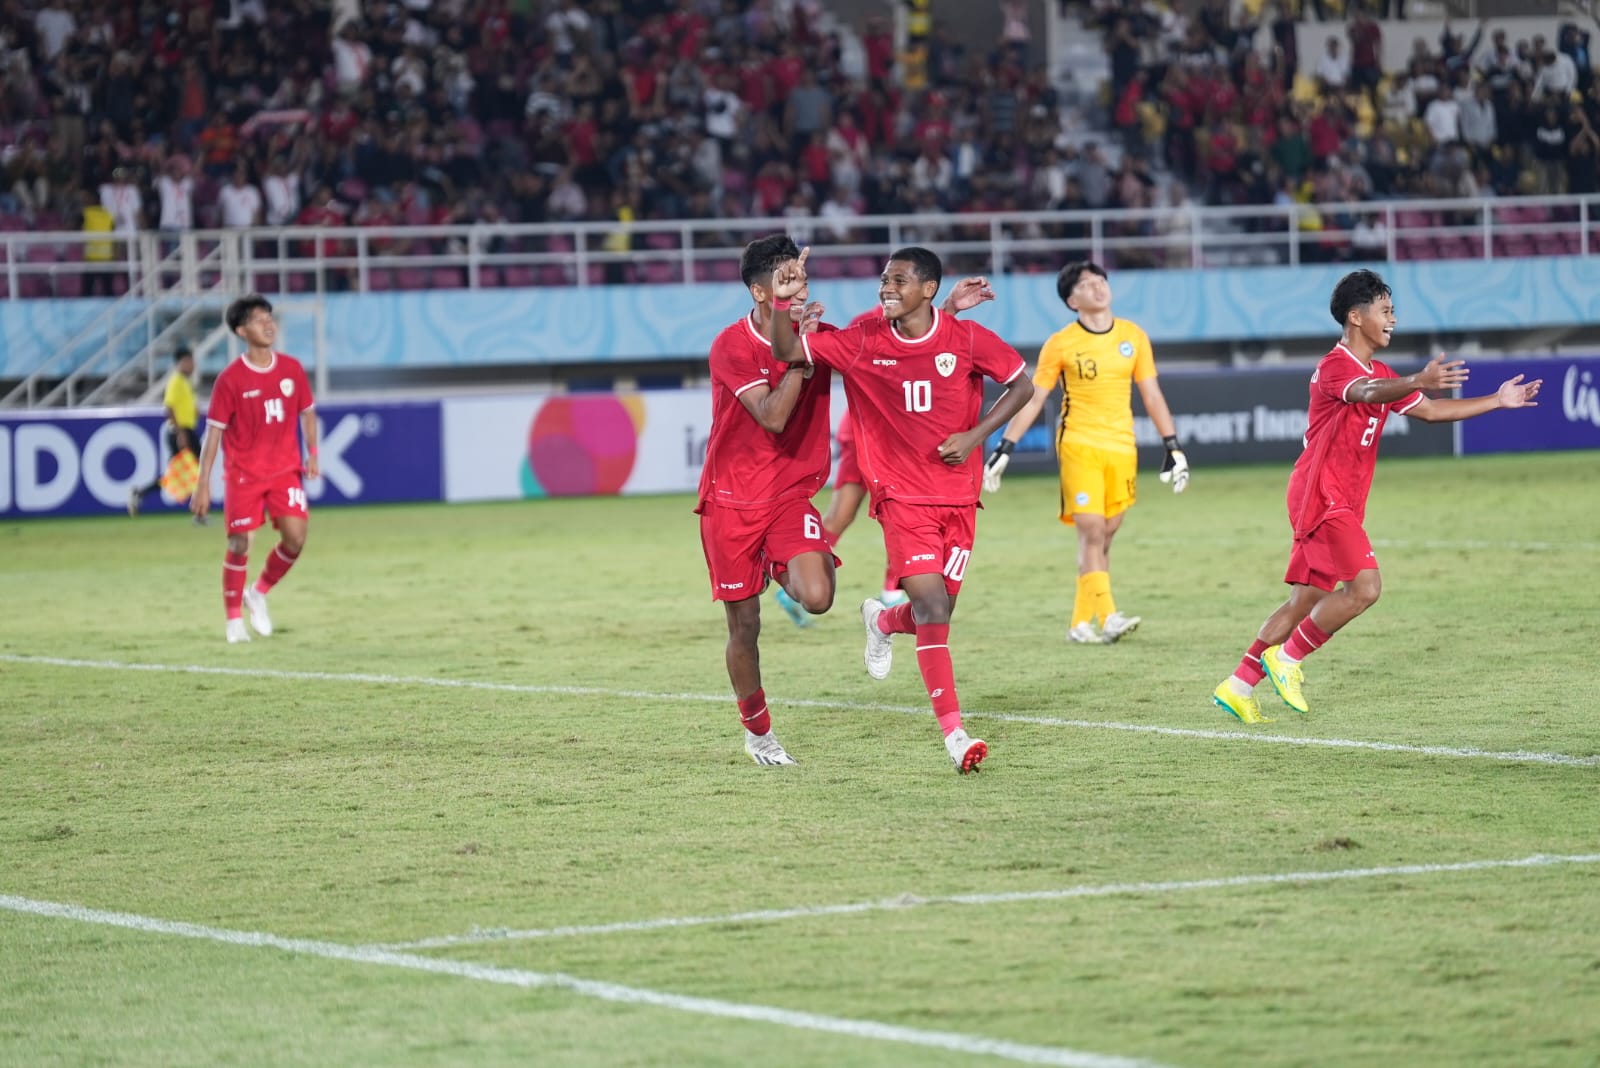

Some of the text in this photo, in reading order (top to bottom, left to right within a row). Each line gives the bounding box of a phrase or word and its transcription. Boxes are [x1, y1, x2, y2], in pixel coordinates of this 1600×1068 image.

[1075, 358, 1097, 381] 13
[902, 380, 932, 413] 10
[264, 398, 284, 424] 14
[287, 487, 308, 512] 14
[804, 513, 821, 540] 6
[943, 546, 971, 582] 10
